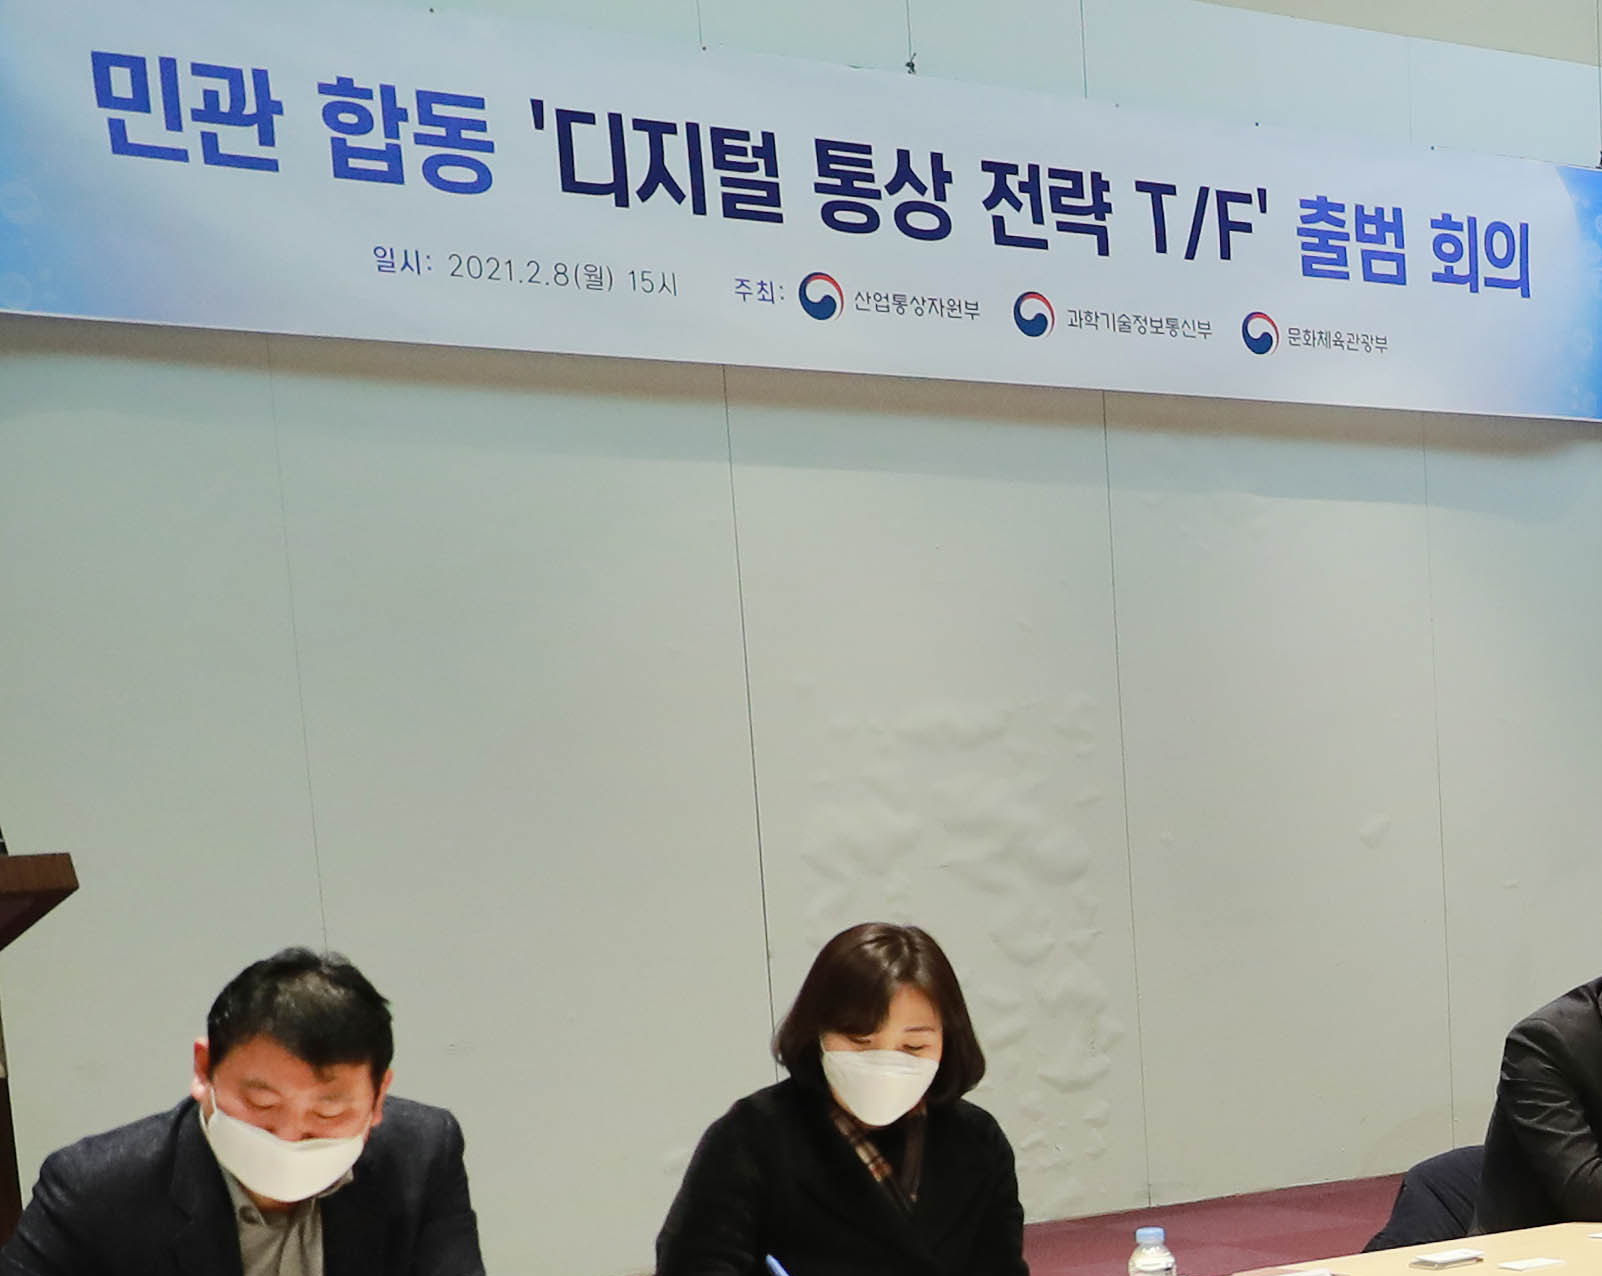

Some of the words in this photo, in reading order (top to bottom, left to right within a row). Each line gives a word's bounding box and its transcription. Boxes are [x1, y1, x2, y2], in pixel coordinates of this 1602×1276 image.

[91, 51, 283, 172] 민관
[318, 76, 494, 195] 합동
[530, 99, 783, 223] '디지털
[814, 138, 953, 241] 통상
[981, 160, 1112, 256] 전략
[1135, 180, 1267, 260] T/F'
[1297, 195, 1406, 286] 출범
[1431, 213, 1530, 298] 회의
[374, 246, 431, 275] 일시:
[449, 254, 613, 291] 2021.2.8(월)
[629, 270, 676, 296] 15시
[735, 279, 784, 304] 주최:
[855, 291, 980, 321] 산업통상자원부
[1068, 309, 1212, 340] 과학기술정보통신부
[1288, 327, 1388, 353] 문화체육관광부
